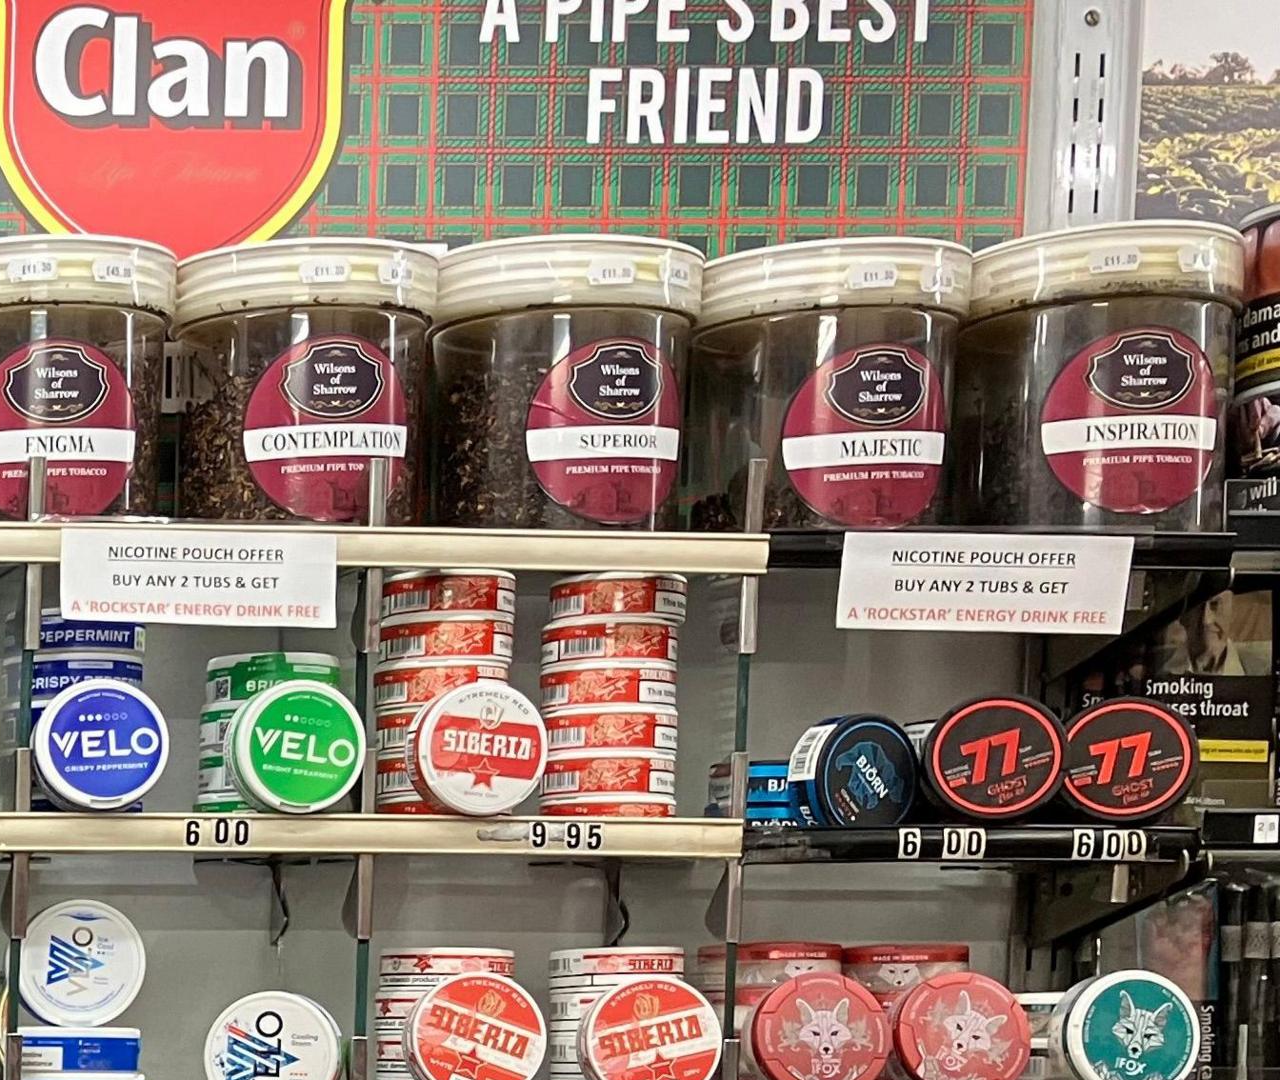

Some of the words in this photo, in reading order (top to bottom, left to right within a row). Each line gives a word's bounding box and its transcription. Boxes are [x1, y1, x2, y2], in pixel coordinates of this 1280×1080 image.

[32, 8, 291, 119] Clan
[586, 67, 824, 144] FRIEND
[1123, 353, 1168, 366] Wilsons
[1121, 374, 1168, 388] Sharrow
[578, 433, 658, 450] SUPERIOR
[1085, 422, 1198, 443] INSPIRATION
[24, 434, 95, 455] ENIGMA
[260, 432, 401, 452] CONTEMPLATION
[840, 438, 922, 458] MAJESTIC
[108, 546, 178, 560] NICOTINE
[182, 548, 234, 561] POUCH
[238, 549, 284, 561] OFFER
[892, 550, 966, 565] NICOTINE
[969, 551, 1024, 566] POUCH
[1028, 552, 1076, 566] OFFER
[112, 575, 141, 587] BUY
[146, 575, 177, 588] ANY
[181, 576, 188, 588] 2
[194, 576, 230, 588] TUBS
[235, 577, 246, 588] &
[251, 577, 279, 589] GET
[894, 579, 926, 593] BUY
[929, 579, 963, 594] ANY
[966, 580, 974, 594] 2
[980, 580, 1019, 594] TUBS
[1022, 581, 1035, 594] &
[1039, 581, 1069, 595] GET
[71, 601, 81, 612] A
[174, 603, 232, 617] ENERGY
[236, 605, 282, 617] DRINK
[288, 605, 320, 618] FREE
[847, 608, 858, 620] A
[955, 609, 1017, 625] ENERGY
[1020, 609, 1068, 624] DRINK
[1073, 610, 1107, 625] FREE
[51, 725, 160, 760] VELO
[255, 725, 355, 766] VELO
[856, 754, 888, 799] BJÖRN
